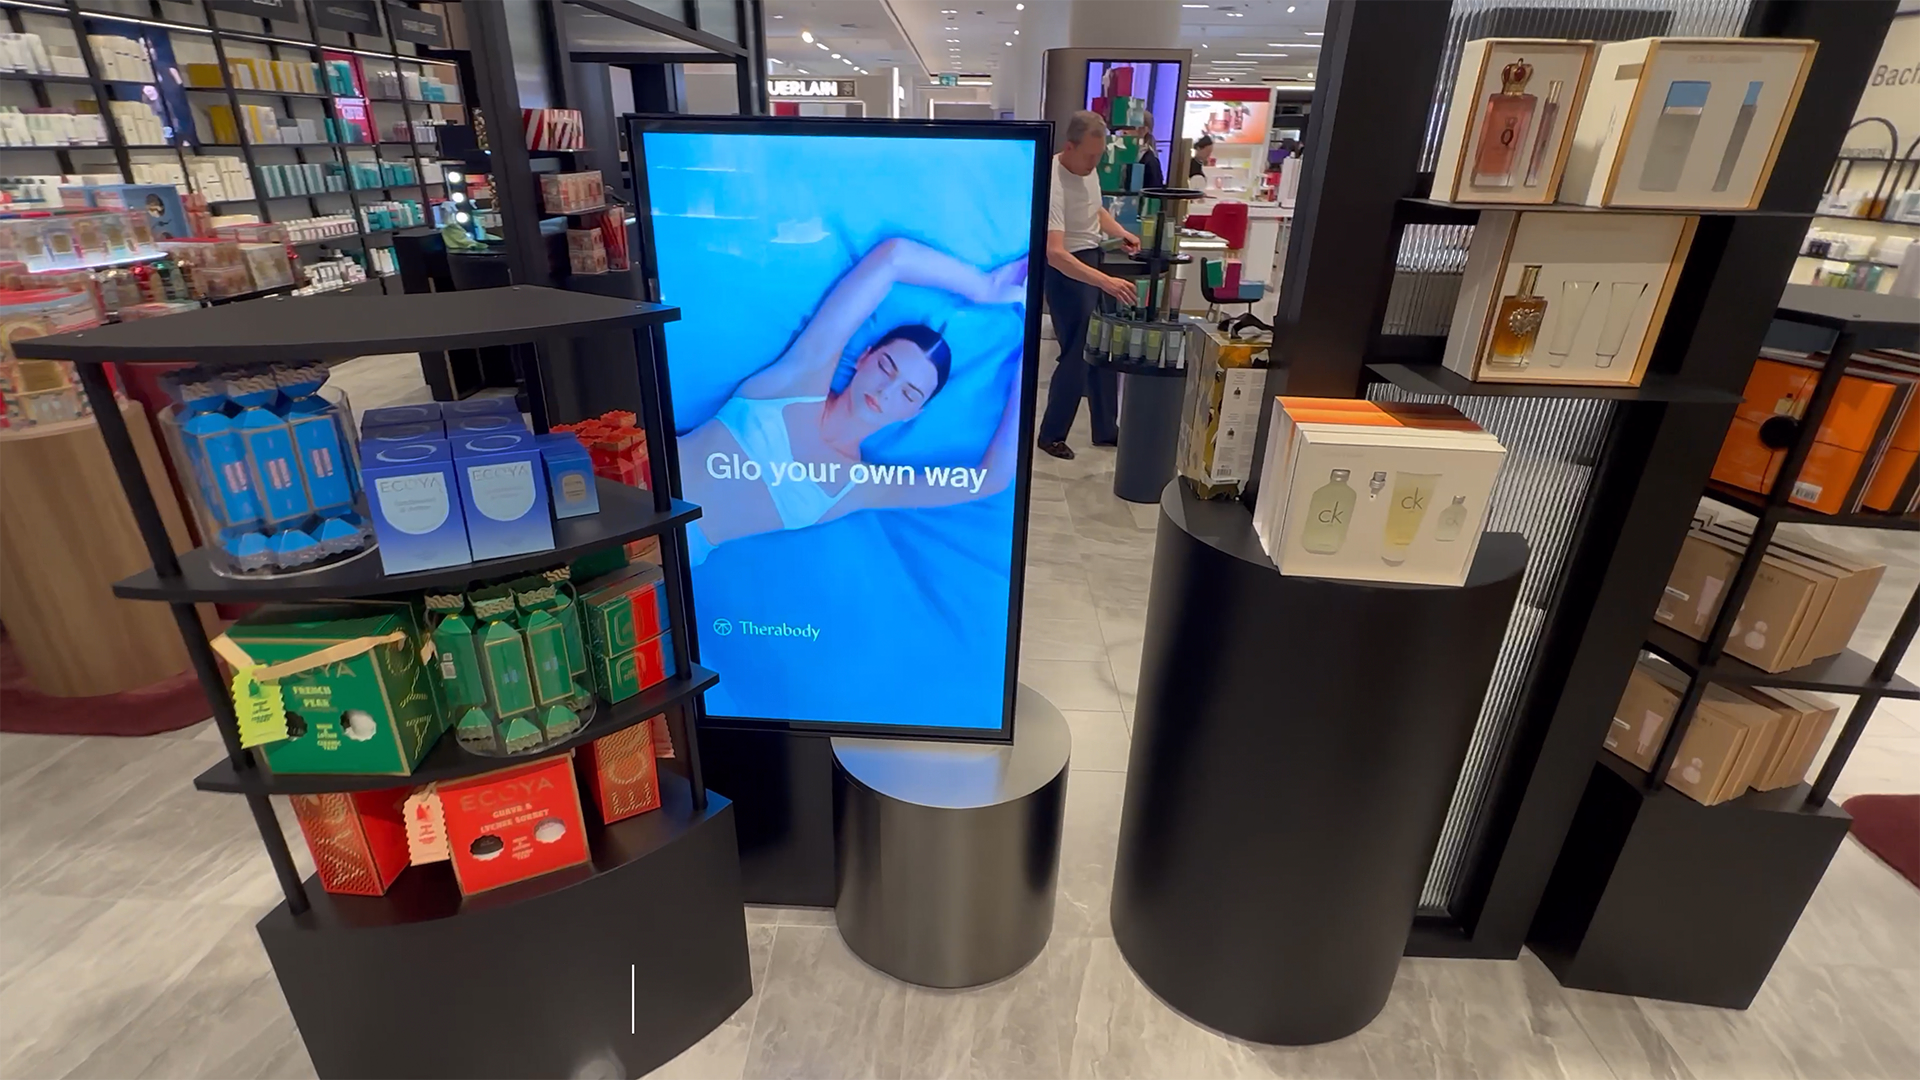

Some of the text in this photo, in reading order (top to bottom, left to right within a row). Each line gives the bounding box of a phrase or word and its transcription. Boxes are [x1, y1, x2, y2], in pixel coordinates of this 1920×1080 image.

[706, 452, 988, 493] Glo your own way
[380, 477, 443, 494] ECOYA
[1401, 487, 1424, 510] ck
[1318, 501, 1344, 524] ck
[738, 620, 821, 642] Therabody
[459, 776, 554, 812] ECOYA
